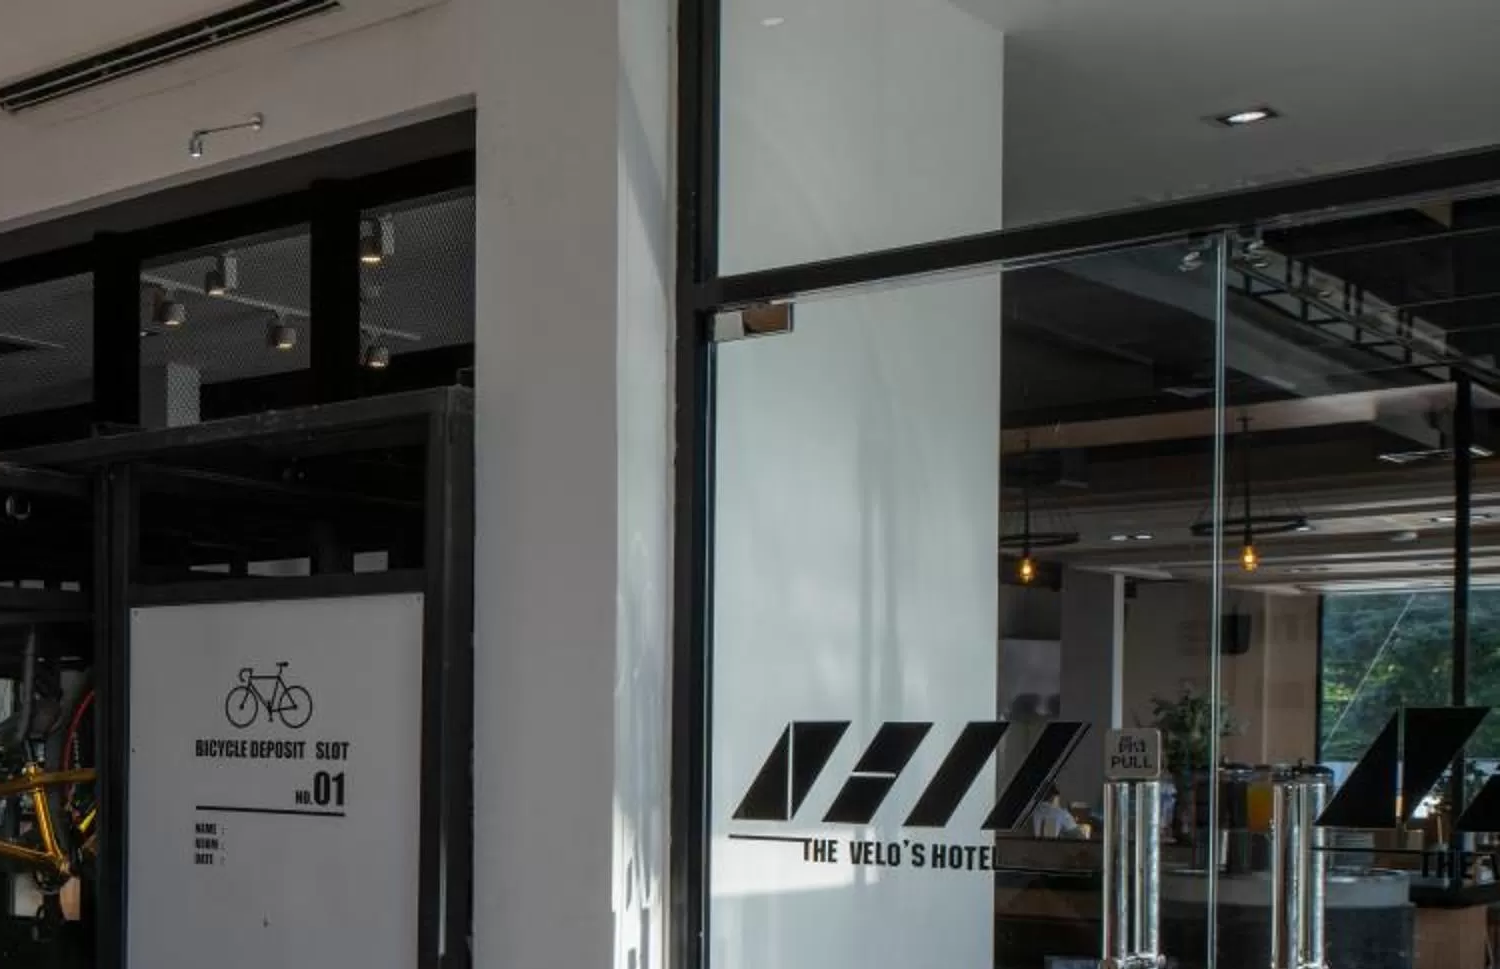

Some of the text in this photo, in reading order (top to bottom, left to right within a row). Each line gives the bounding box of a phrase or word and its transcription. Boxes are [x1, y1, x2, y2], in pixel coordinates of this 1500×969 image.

[195, 739, 350, 760] BICYCLE DEPOSIT SLOT
[1111, 755, 1152, 768] PULL
[802, 838, 838, 863] THE
[849, 838, 926, 868] VELO'S
